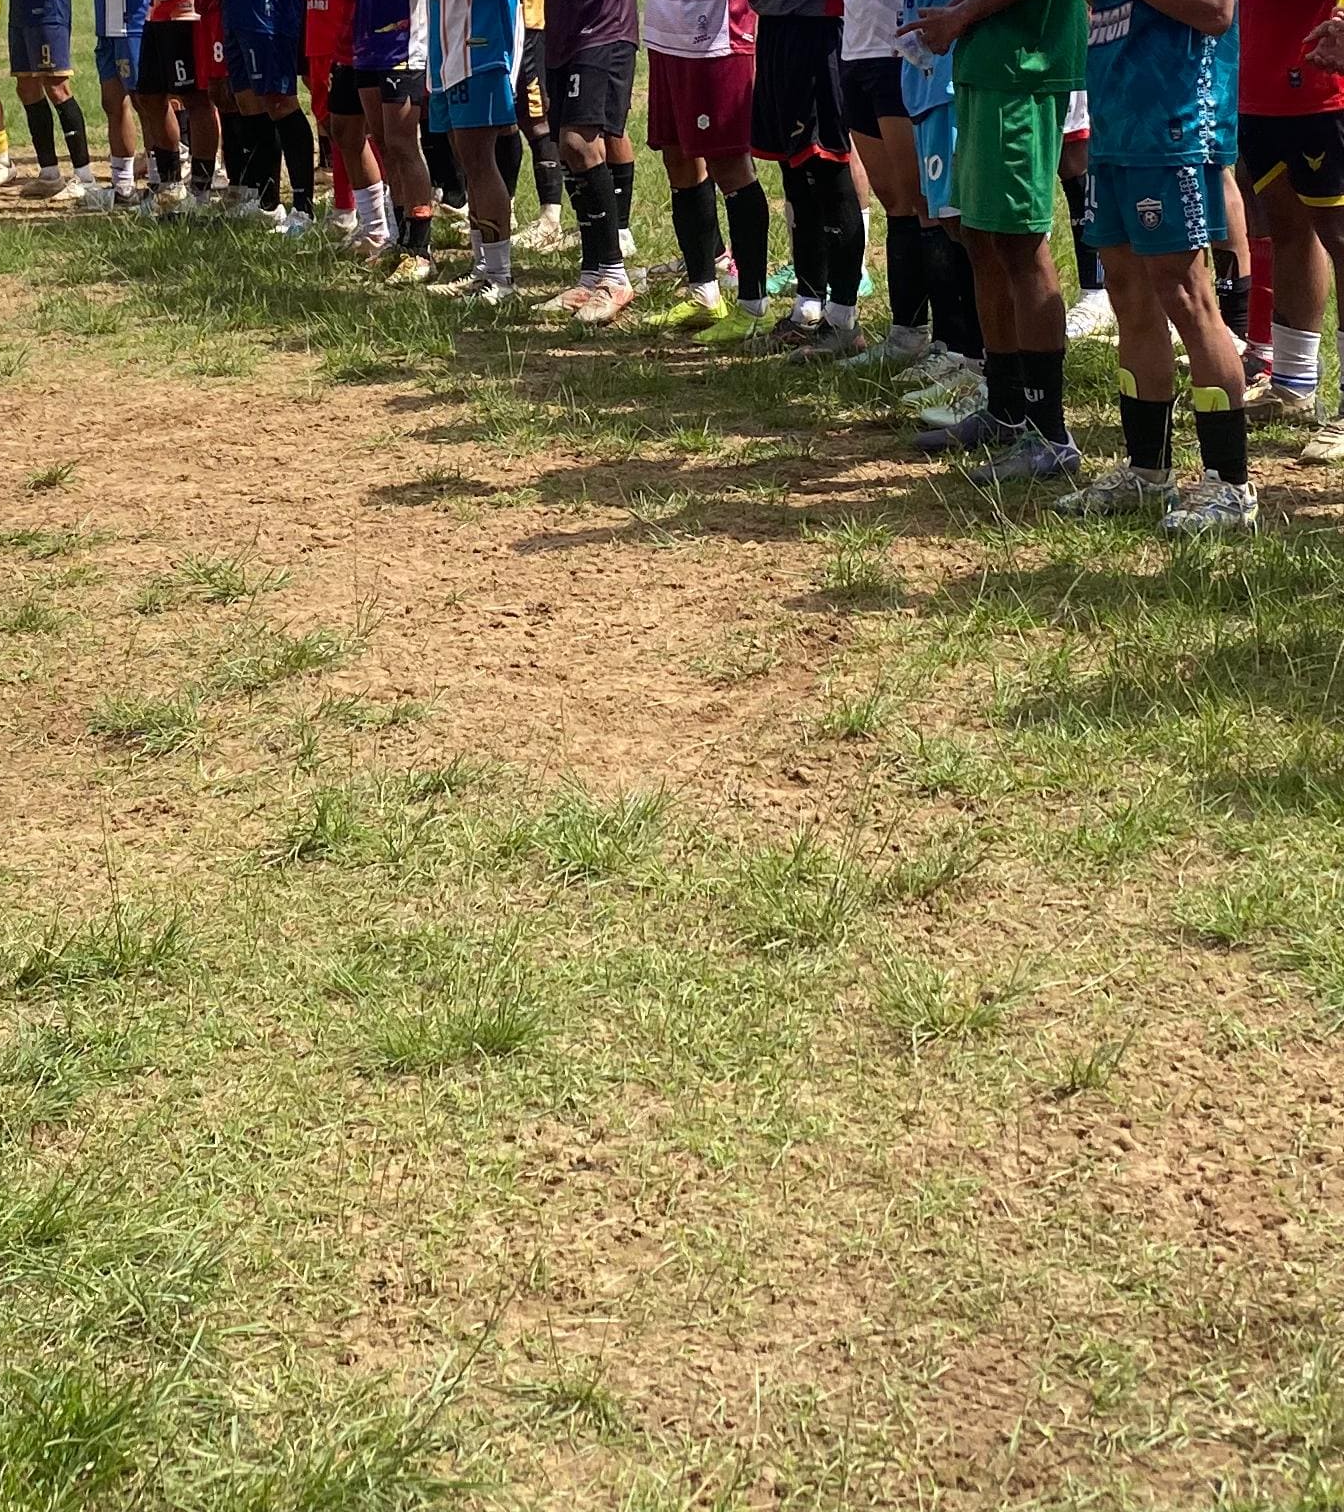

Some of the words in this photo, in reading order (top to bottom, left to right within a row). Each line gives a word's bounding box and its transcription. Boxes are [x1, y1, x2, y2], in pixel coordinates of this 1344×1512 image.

[41, 44, 51, 65] 9
[213, 41, 224, 63] 8
[174, 59, 187, 82] 6
[567, 74, 580, 98] 3
